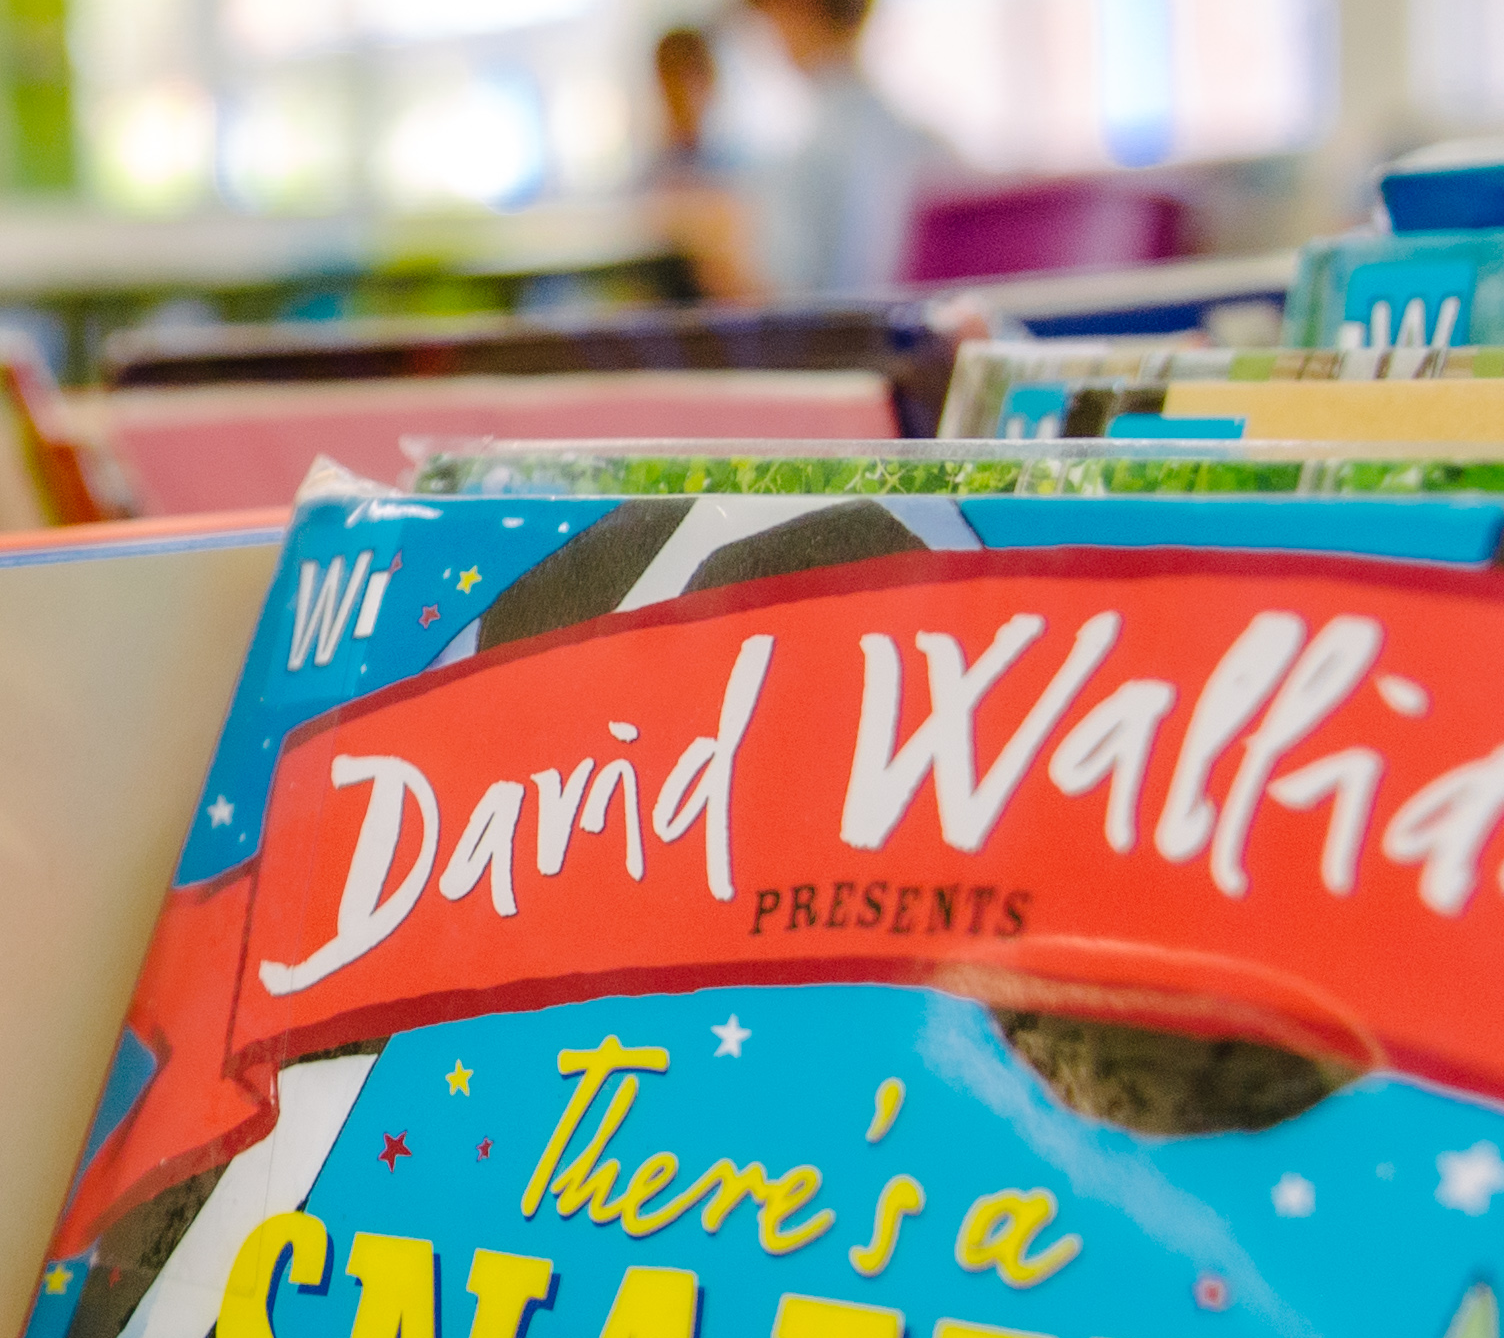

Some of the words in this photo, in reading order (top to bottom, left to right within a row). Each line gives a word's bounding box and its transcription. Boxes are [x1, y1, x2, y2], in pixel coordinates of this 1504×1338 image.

[258, 633, 776, 997] David
[748, 882, 1035, 940] PRESENTS
[520, 1032, 926, 1277] There's
[954, 1183, 1083, 1289] a
